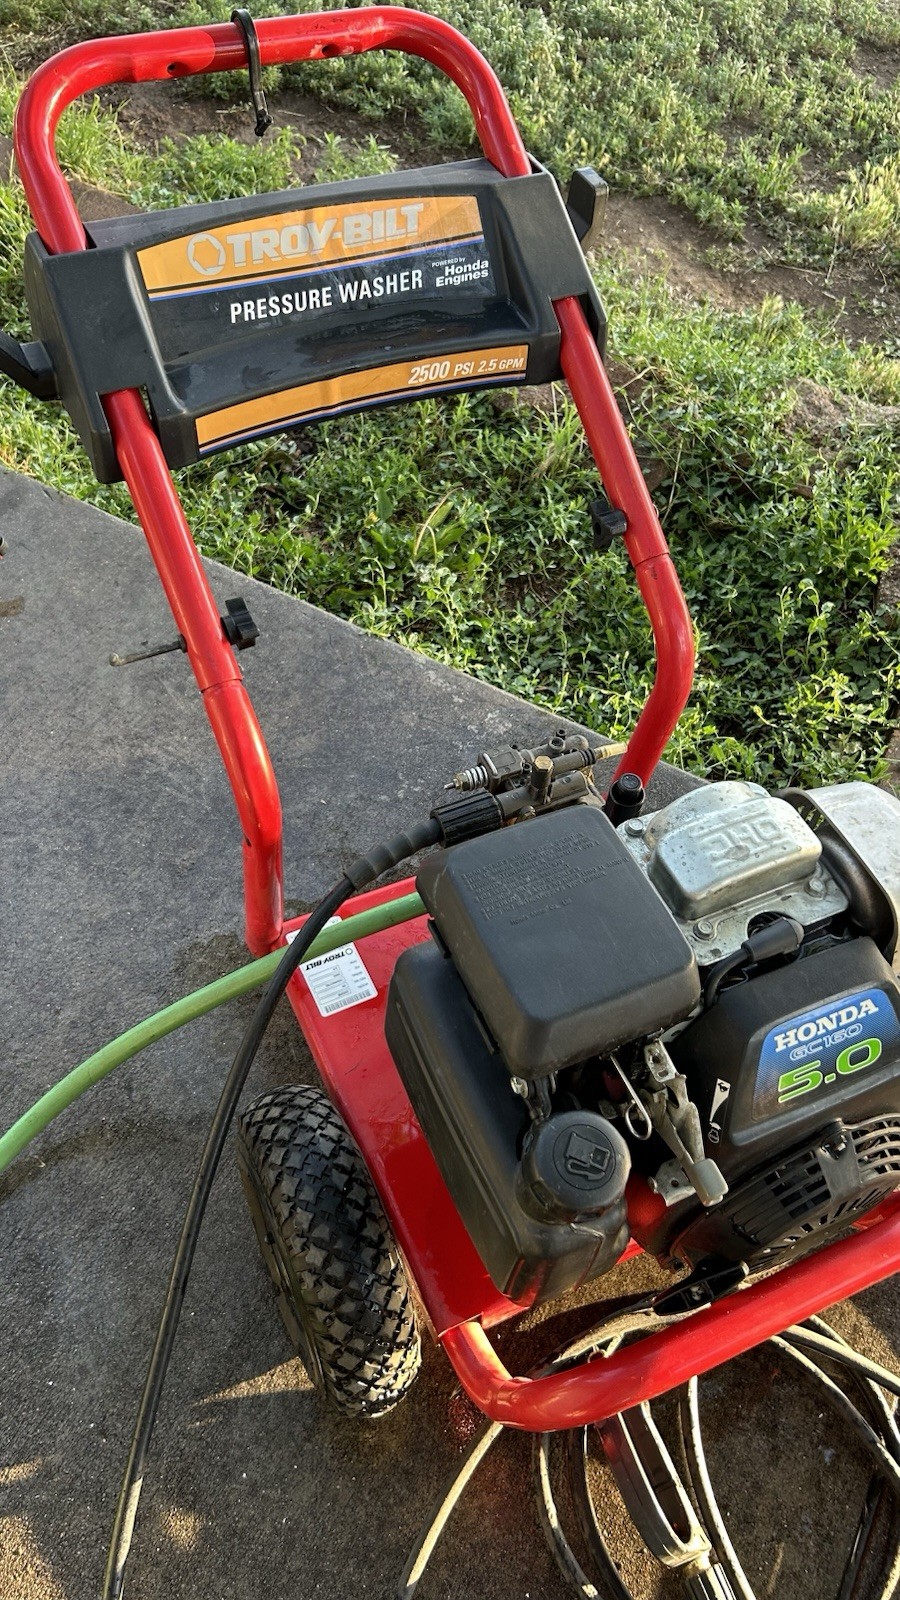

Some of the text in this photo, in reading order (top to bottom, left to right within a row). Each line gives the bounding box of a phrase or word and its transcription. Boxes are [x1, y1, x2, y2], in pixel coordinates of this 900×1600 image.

[226, 203, 424, 268] TROY-BILT
[431, 258, 459, 268] POWERED
[435, 269, 489, 288] Engines
[444, 259, 489, 277] Honda
[230, 269, 423, 324] PRESSURE WASHER
[407, 357, 525, 385] 2500 PSI 2.5 GPM
[773, 998, 879, 1055] HONDA
[789, 1022, 863, 1061] GC160
[777, 1037, 882, 1103] 5.0
